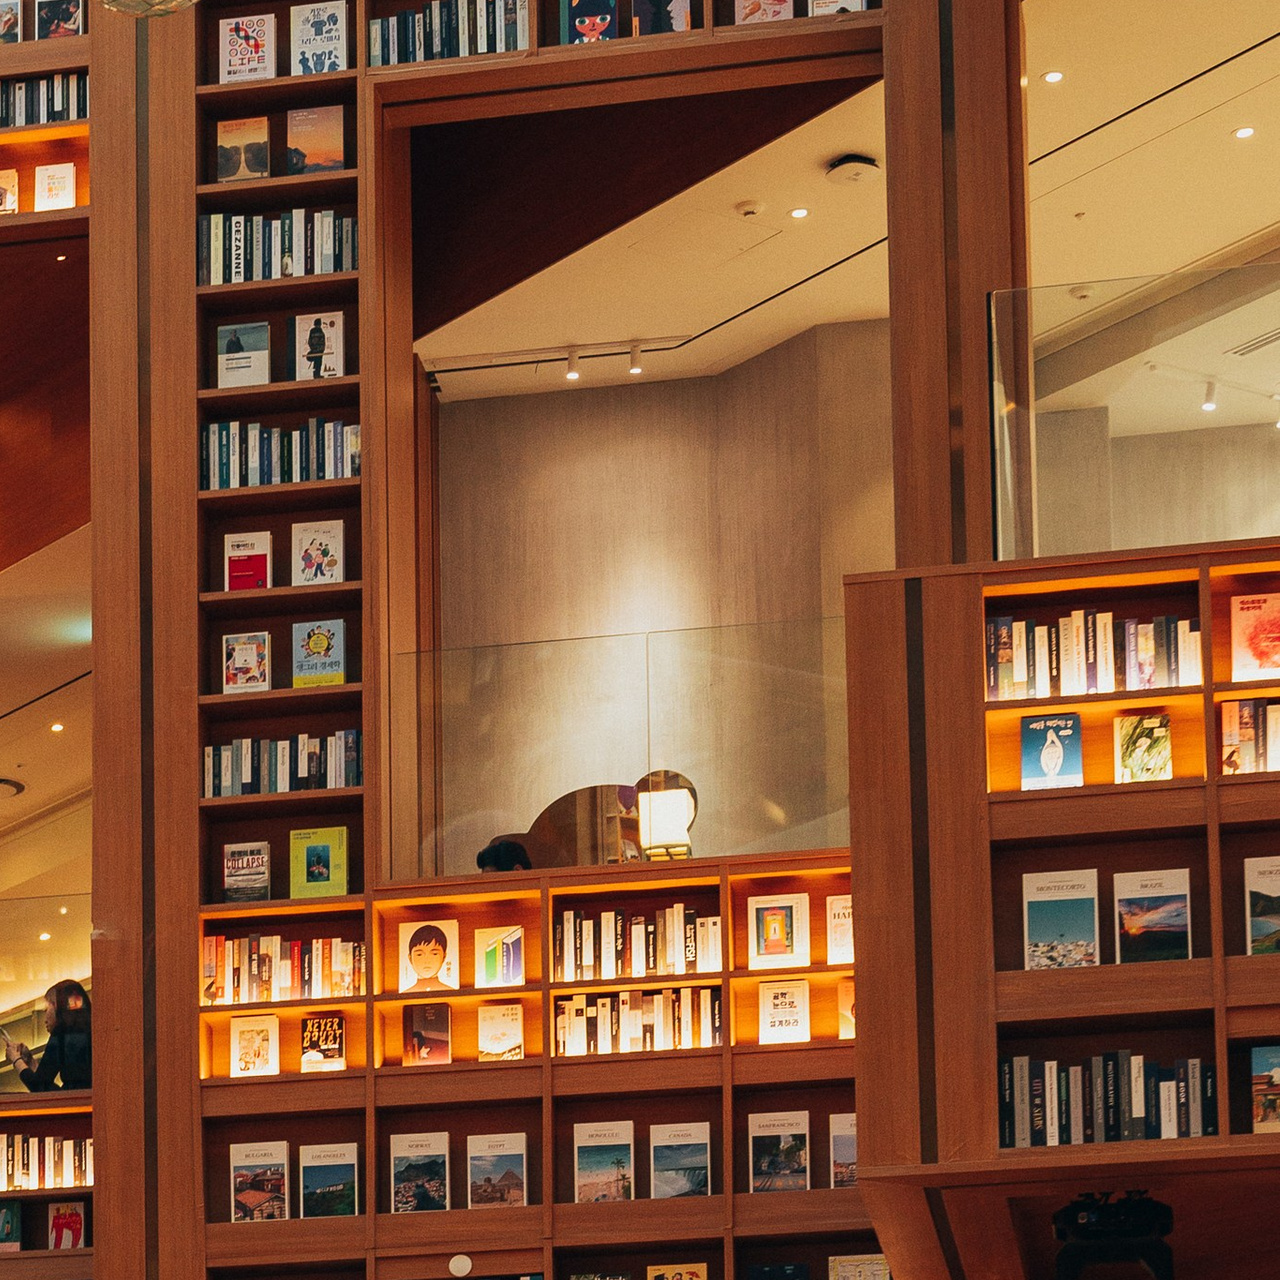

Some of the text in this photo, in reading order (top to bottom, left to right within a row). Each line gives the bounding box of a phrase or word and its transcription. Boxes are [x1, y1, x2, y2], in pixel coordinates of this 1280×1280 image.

[228, 55, 266, 68] LIFE
[233, 220, 243, 278] CEZANNE
[225, 856, 265, 870] COLLAPSE
[306, 1017, 339, 1032] NEVER
[303, 1030, 343, 1048] DOUBT
